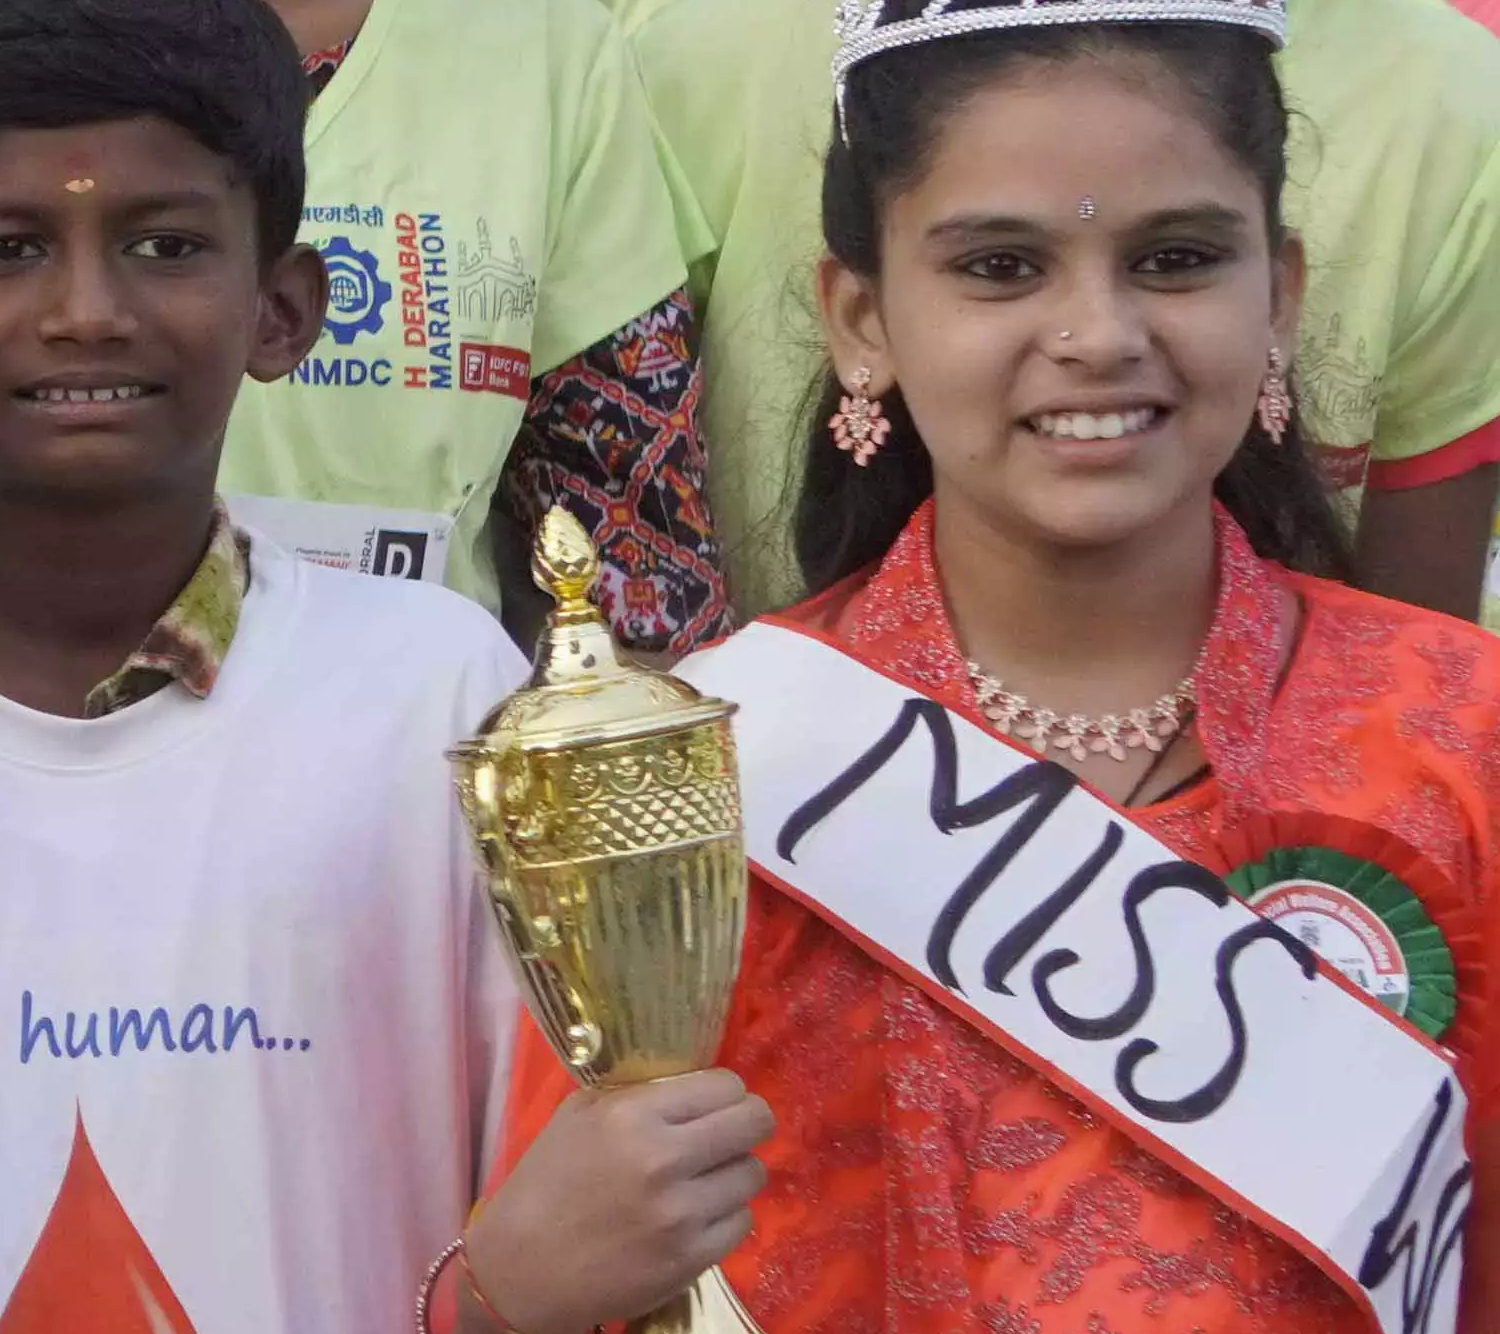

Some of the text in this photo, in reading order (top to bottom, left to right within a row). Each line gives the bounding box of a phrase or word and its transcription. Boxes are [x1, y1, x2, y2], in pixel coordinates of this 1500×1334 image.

[418, 213, 453, 390] MARATHON
[288, 358, 393, 387] NMDC
[384, 541, 413, 579] D
[775, 696, 1318, 1124] MISS
